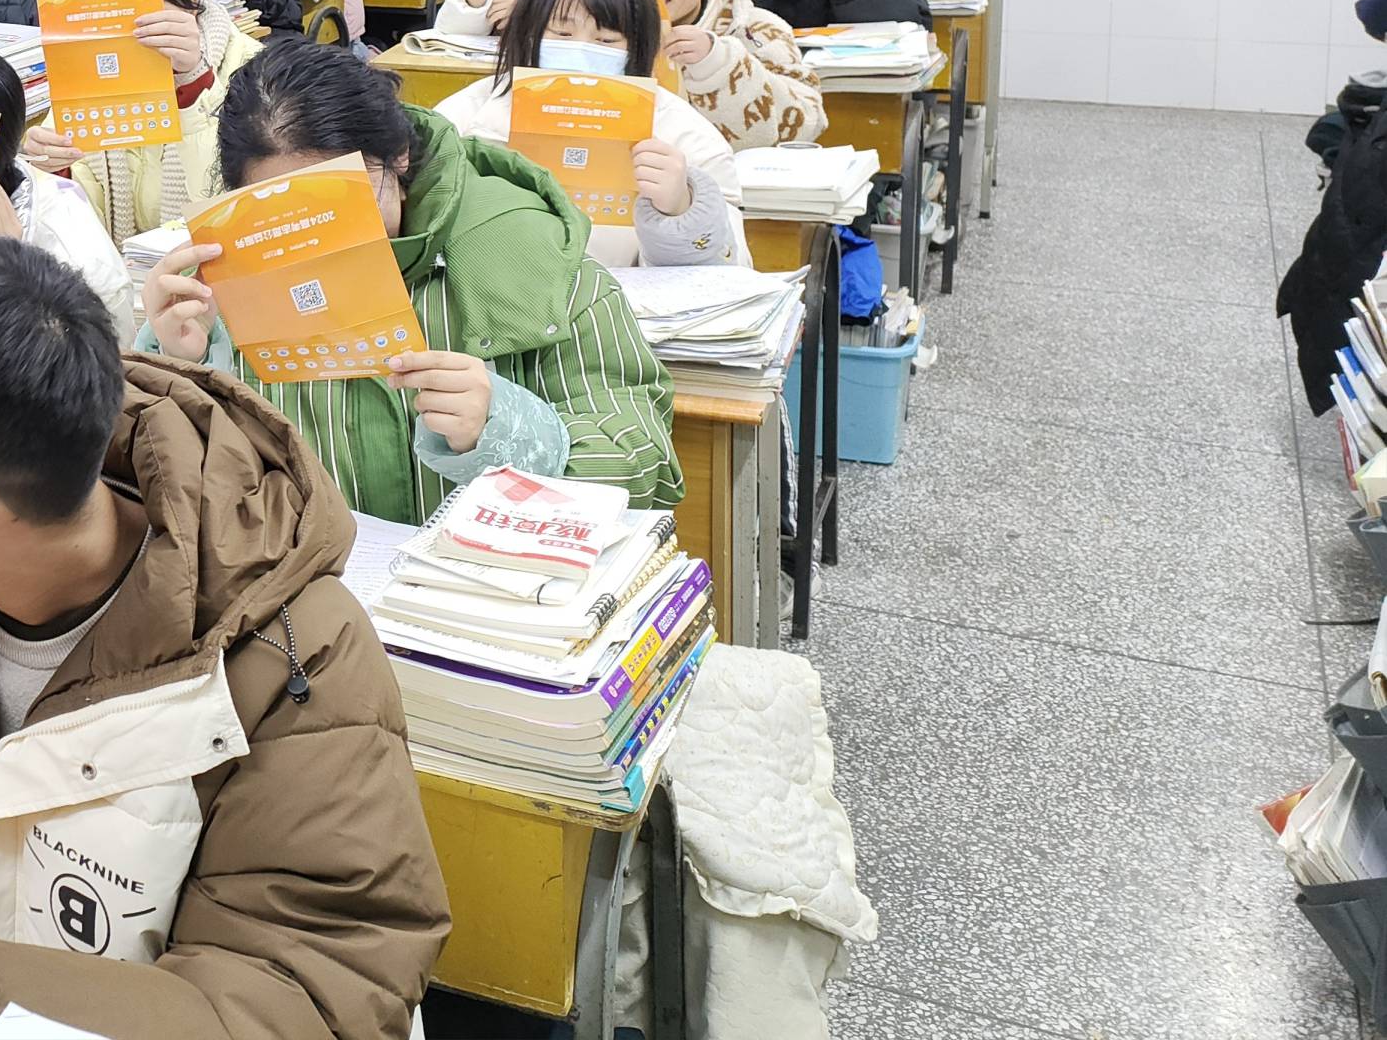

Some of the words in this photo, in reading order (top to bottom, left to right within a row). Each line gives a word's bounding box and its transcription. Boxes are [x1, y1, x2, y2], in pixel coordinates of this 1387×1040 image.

[233, 209, 337, 250] 2024高考志愿公益服务
[32, 825, 146, 895] BLACKNINE
